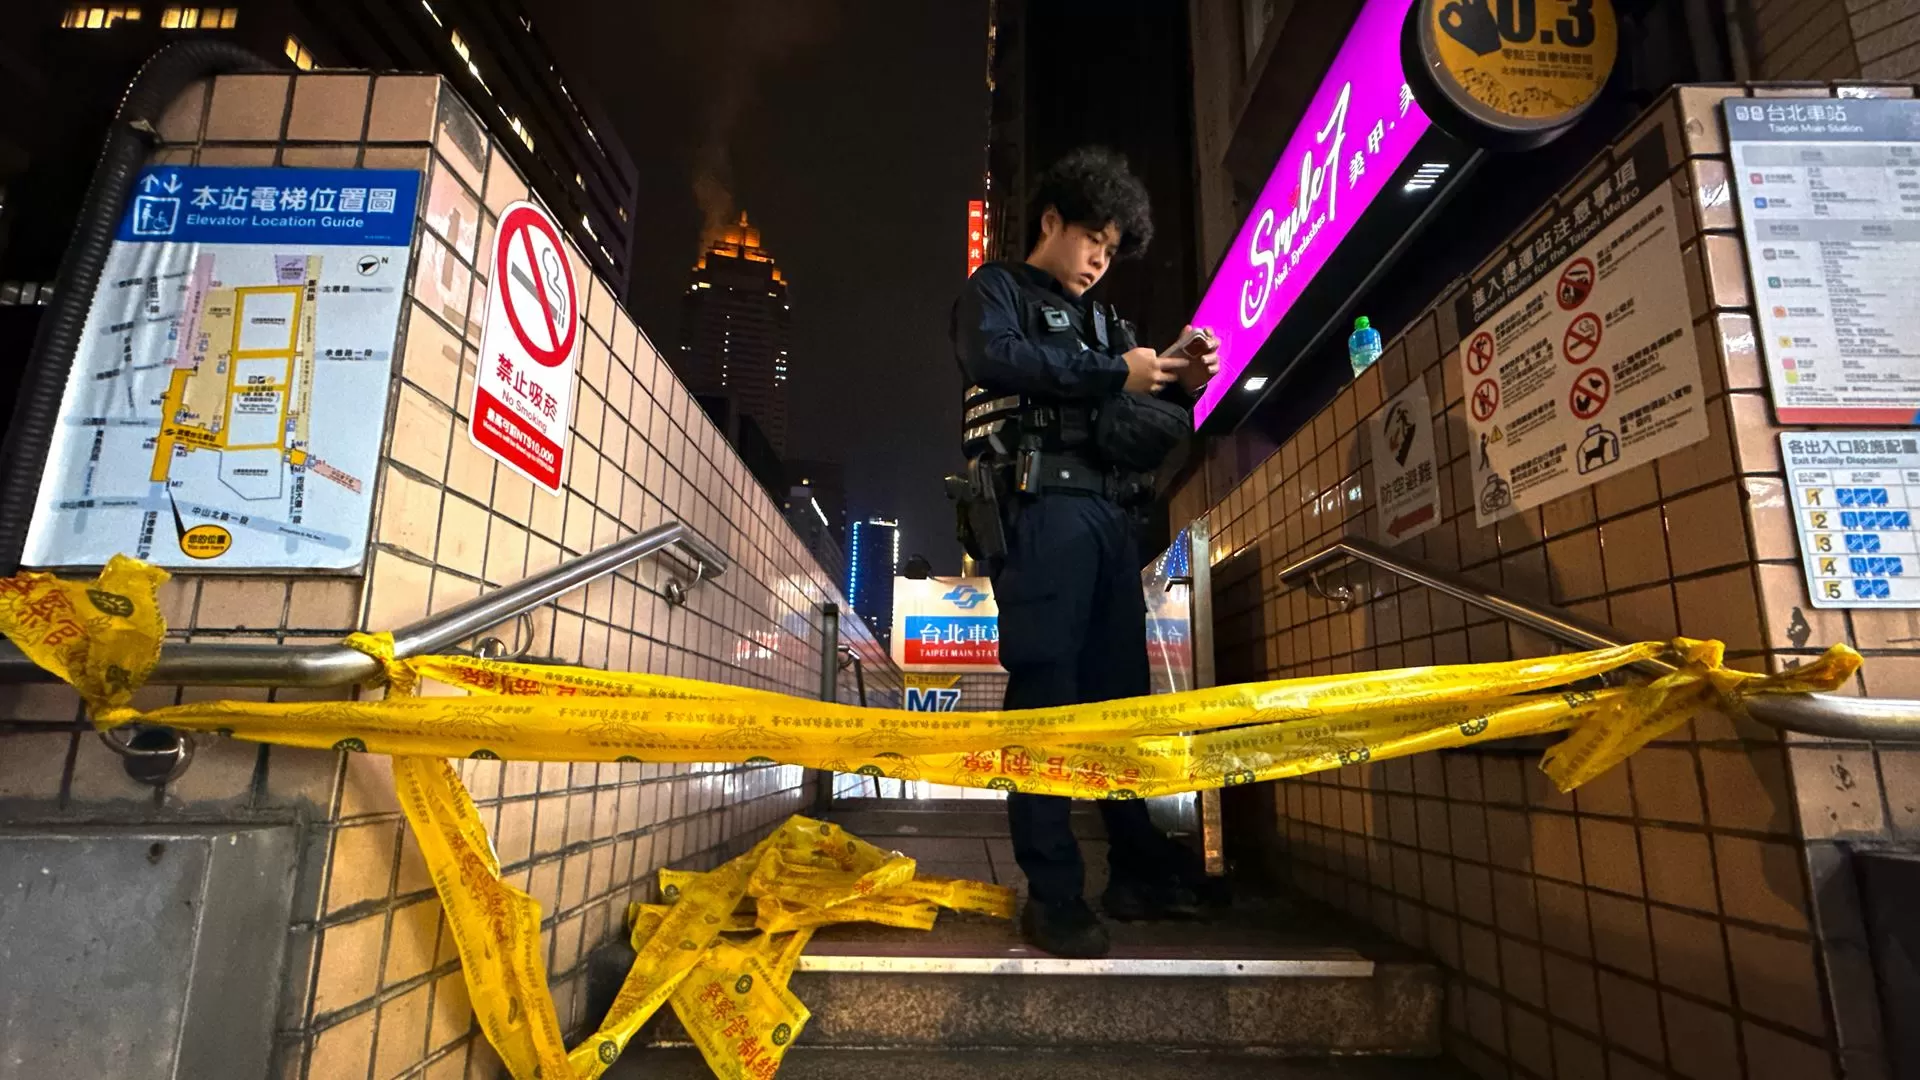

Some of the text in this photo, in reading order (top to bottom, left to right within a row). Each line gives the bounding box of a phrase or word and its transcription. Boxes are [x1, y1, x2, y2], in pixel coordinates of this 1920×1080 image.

[1766, 103, 1847, 122] 台北車站
[1768, 123, 1864, 134] Taipei Main Station
[190, 185, 397, 214] 本站電梯位置圖
[185, 214, 365, 228] Elevator Location Guide
[381, 256, 389, 265] N
[1473, 291, 1507, 324] General
[1506, 275, 1533, 300] Rules
[1533, 260, 1548, 277] for
[1550, 248, 1567, 264] the
[1567, 218, 1601, 247] Taipei
[1602, 186, 1641, 220] Metro
[496, 352, 558, 423] 禁止吸菸
[502, 388, 548, 435] No Smoking
[1787, 439, 1918, 455] 各出入口設施配置
[1791, 456, 1898, 466] Exit Facility Disposition
[1811, 491, 1821, 506] 1
[1815, 514, 1829, 529] 2
[1819, 536, 1832, 552] 3
[1824, 559, 1837, 576] 4
[1829, 583, 1841, 599] 5
[919, 648, 948, 658] TAIPEI
[950, 648, 974, 658] MAIN
[908, 689, 959, 712] M7
